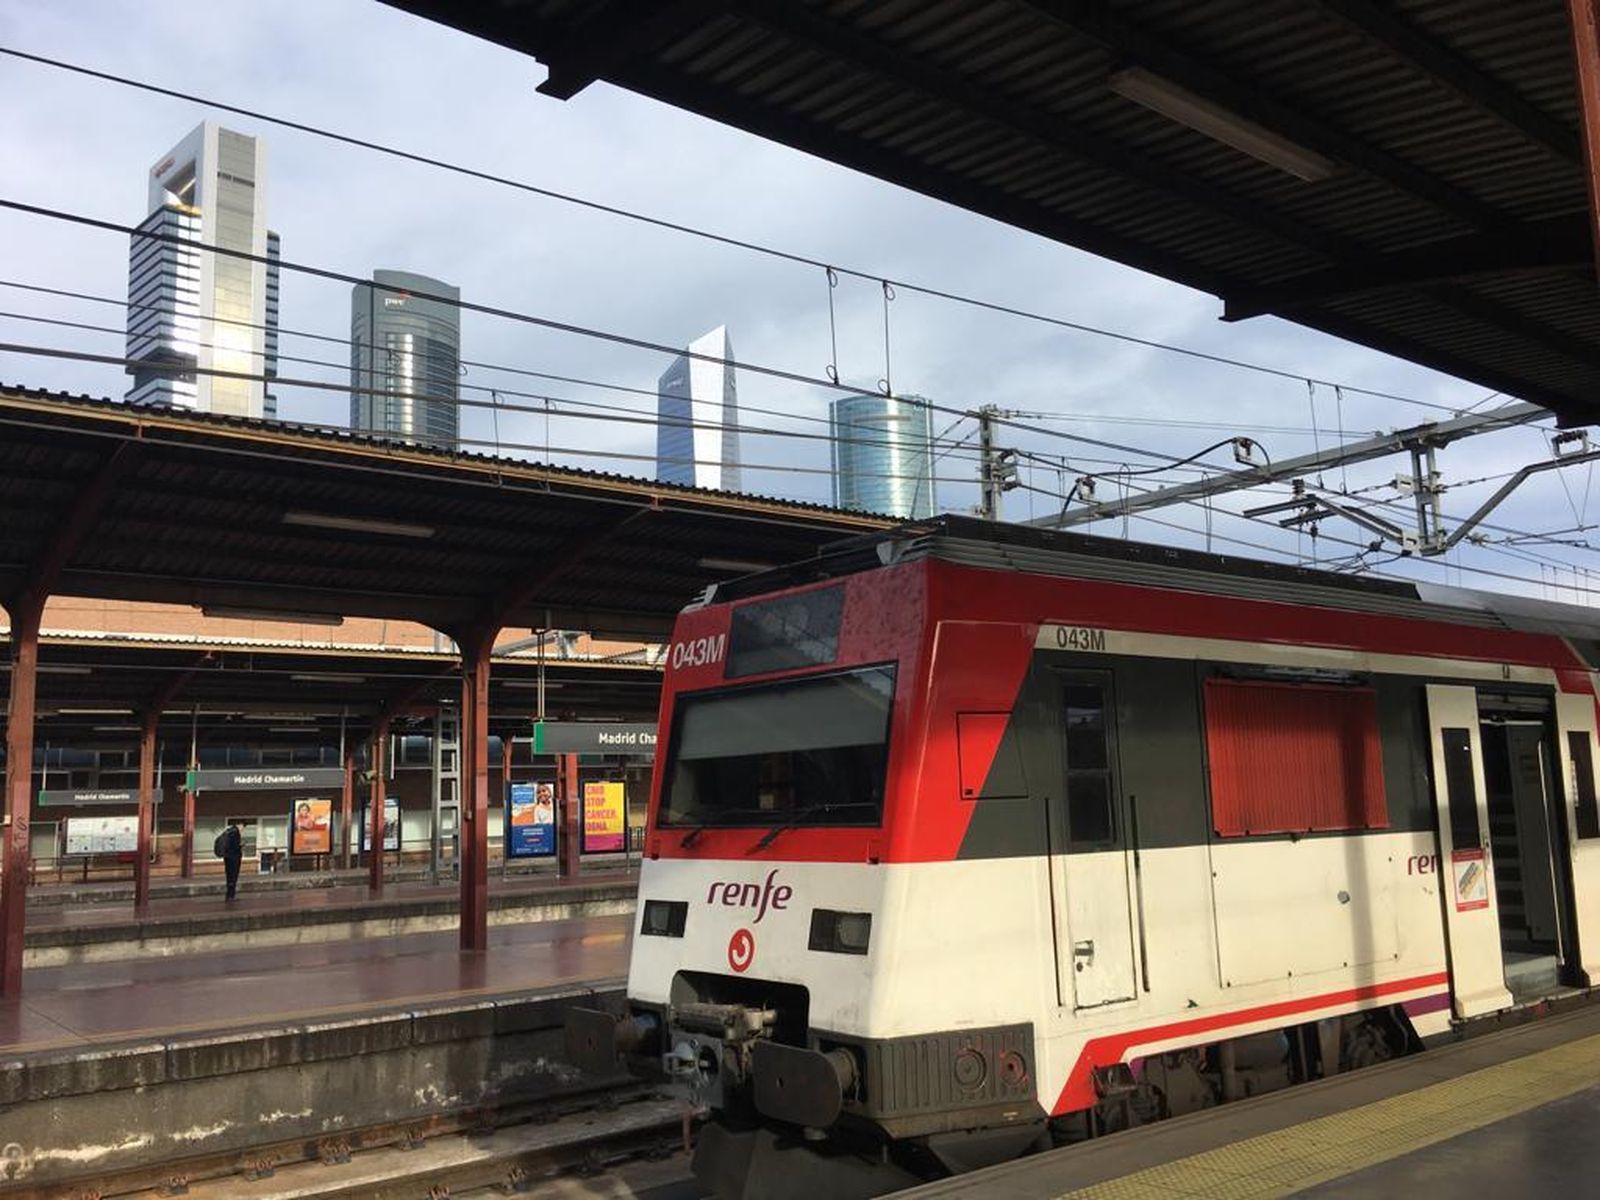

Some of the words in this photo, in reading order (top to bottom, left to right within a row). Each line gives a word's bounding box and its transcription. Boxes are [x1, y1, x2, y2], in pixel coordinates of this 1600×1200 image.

[1056, 626, 1106, 651] 043M
[672, 633, 726, 670] 043M
[599, 732, 636, 744] Madrid
[585, 797, 606, 808] STOP
[706, 869, 793, 924] renfe
